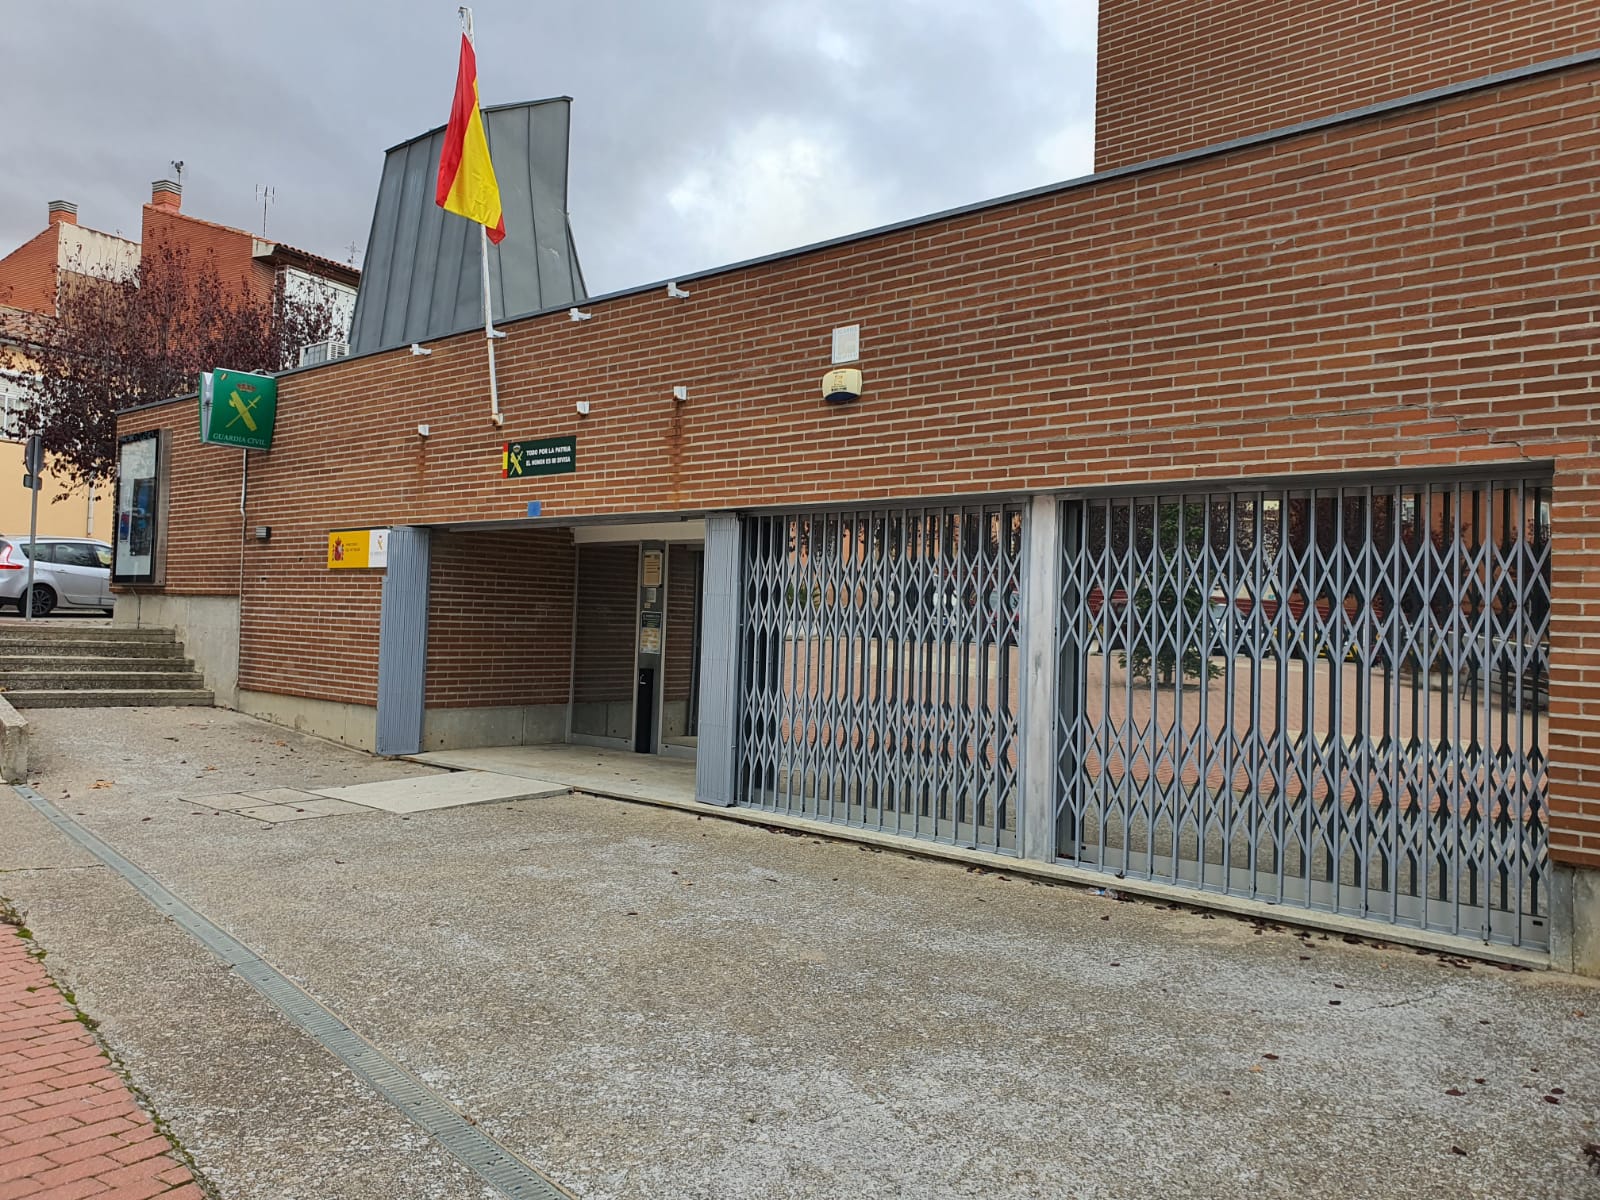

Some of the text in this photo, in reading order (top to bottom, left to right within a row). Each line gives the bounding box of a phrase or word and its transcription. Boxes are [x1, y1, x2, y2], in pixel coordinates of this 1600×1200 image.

[212, 432, 266, 446] GUARDIA CIVIL
[555, 445, 571, 453] PATRIA
